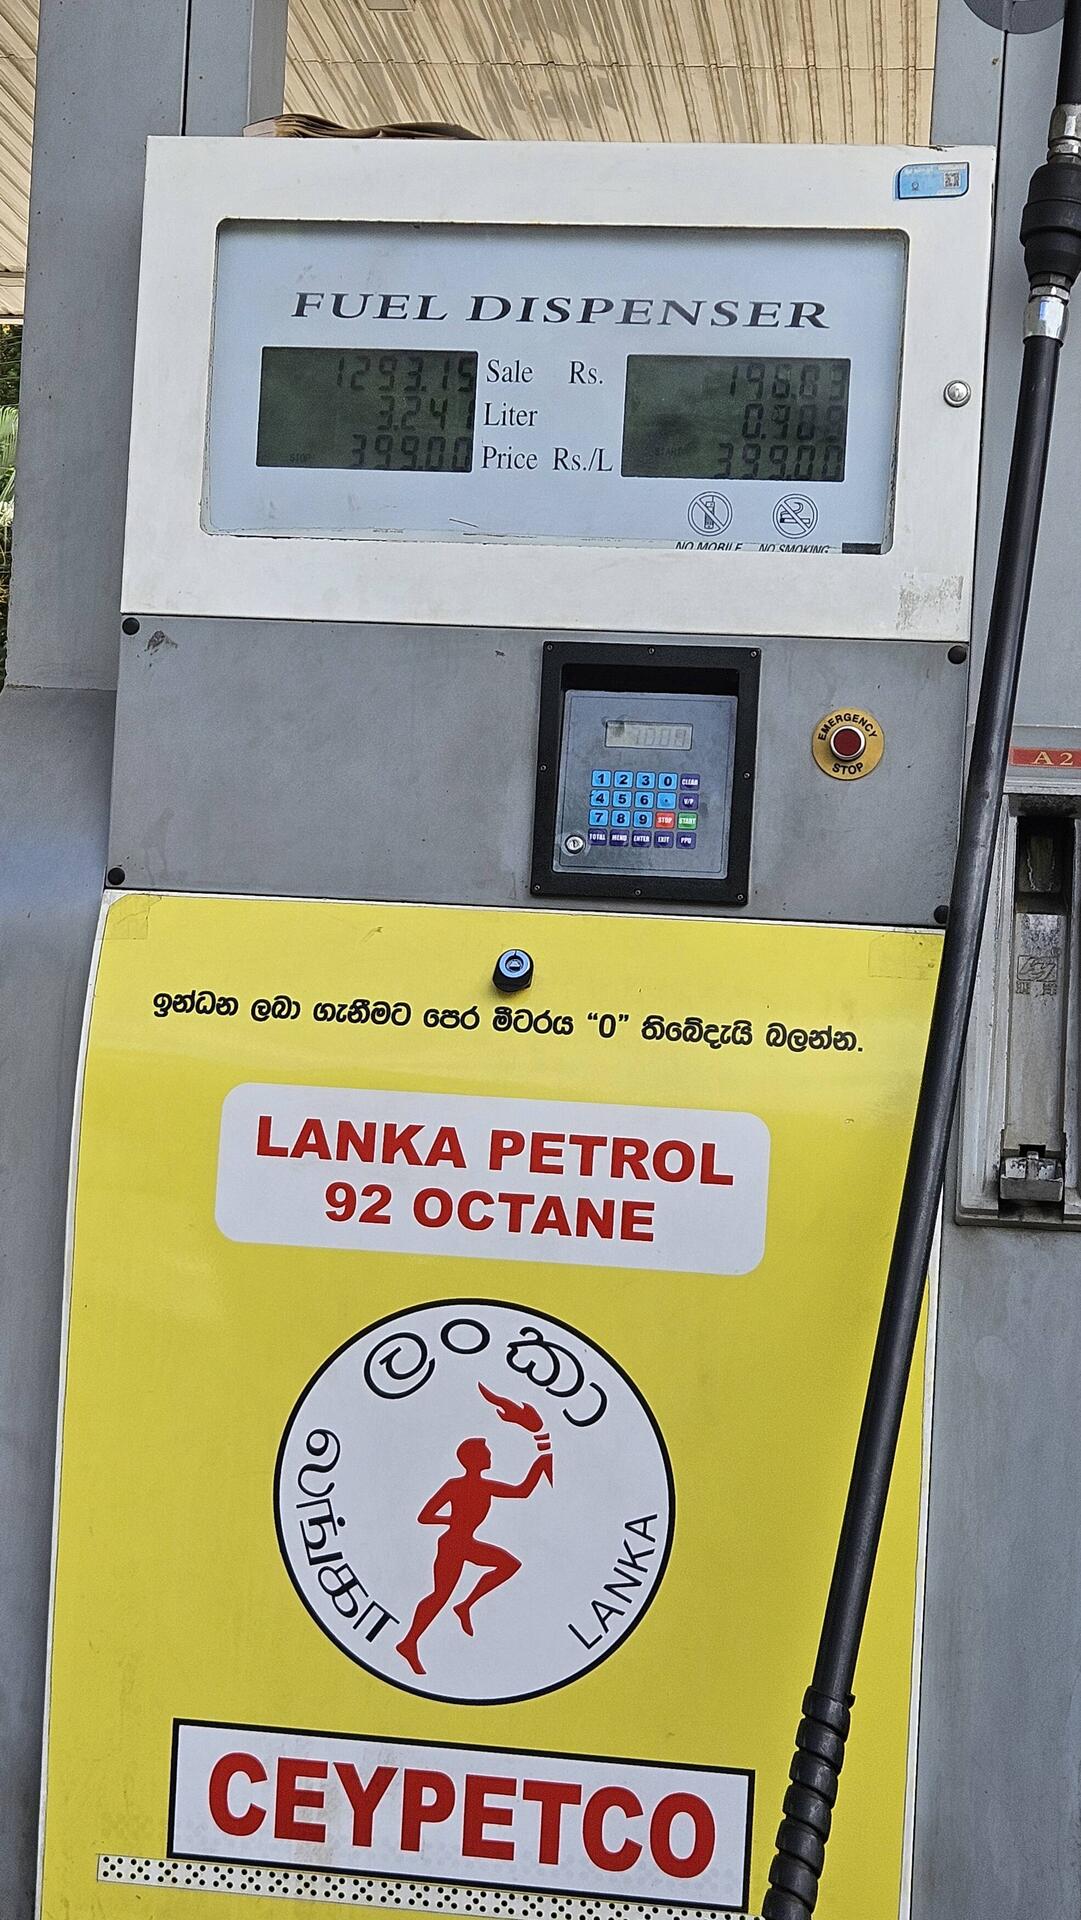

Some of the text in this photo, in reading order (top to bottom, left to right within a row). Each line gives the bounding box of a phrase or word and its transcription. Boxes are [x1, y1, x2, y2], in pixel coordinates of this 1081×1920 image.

[291, 292, 831, 329] FUEL DISPENSER
[337, 356, 475, 392] 1293.15
[486, 359, 603, 384] Sale Rs.
[483, 402, 538, 427] Liter
[352, 434, 472, 470] 399.00
[481, 445, 613, 472] Price Rs./L
[714, 442, 844, 481] 399.00
[818, 712, 878, 741] EMERGENCY
[597, 773, 605, 785] 1
[619, 774, 628, 785] 2
[641, 775, 650, 786] 3
[664, 776, 673, 786] 0
[832, 762, 864, 775] STOP
[596, 793, 604, 803] 4
[618, 794, 627, 804] 5
[640, 794, 649, 805] 6
[595, 812, 604, 823] 7
[617, 813, 625, 824] 8
[639, 814, 648, 825] 9
[657, 816, 673, 824] STOP
[589, 833, 606, 841] TOTAL
[611, 834, 628, 842] MENU
[633, 835, 650, 843] ENTER
[153, 990, 239, 1018] ඉන්ධන
[250, 995, 301, 1022] ලබා
[313, 998, 412, 1027] ගැනීමට
[423, 1006, 480, 1030] පෙර
[492, 1006, 574, 1036] මීටරය
[766, 1022, 863, 1053] බලන්න.
[256, 1115, 735, 1186] LANKA PETROL
[325, 1182, 656, 1242] 92 OCTANE
[363, 1318, 608, 1428] ලංකා
[295, 1427, 401, 1643] லங்கா
[567, 1513, 658, 1650] LANKA
[208, 1752, 716, 1879] CEYPETCO
